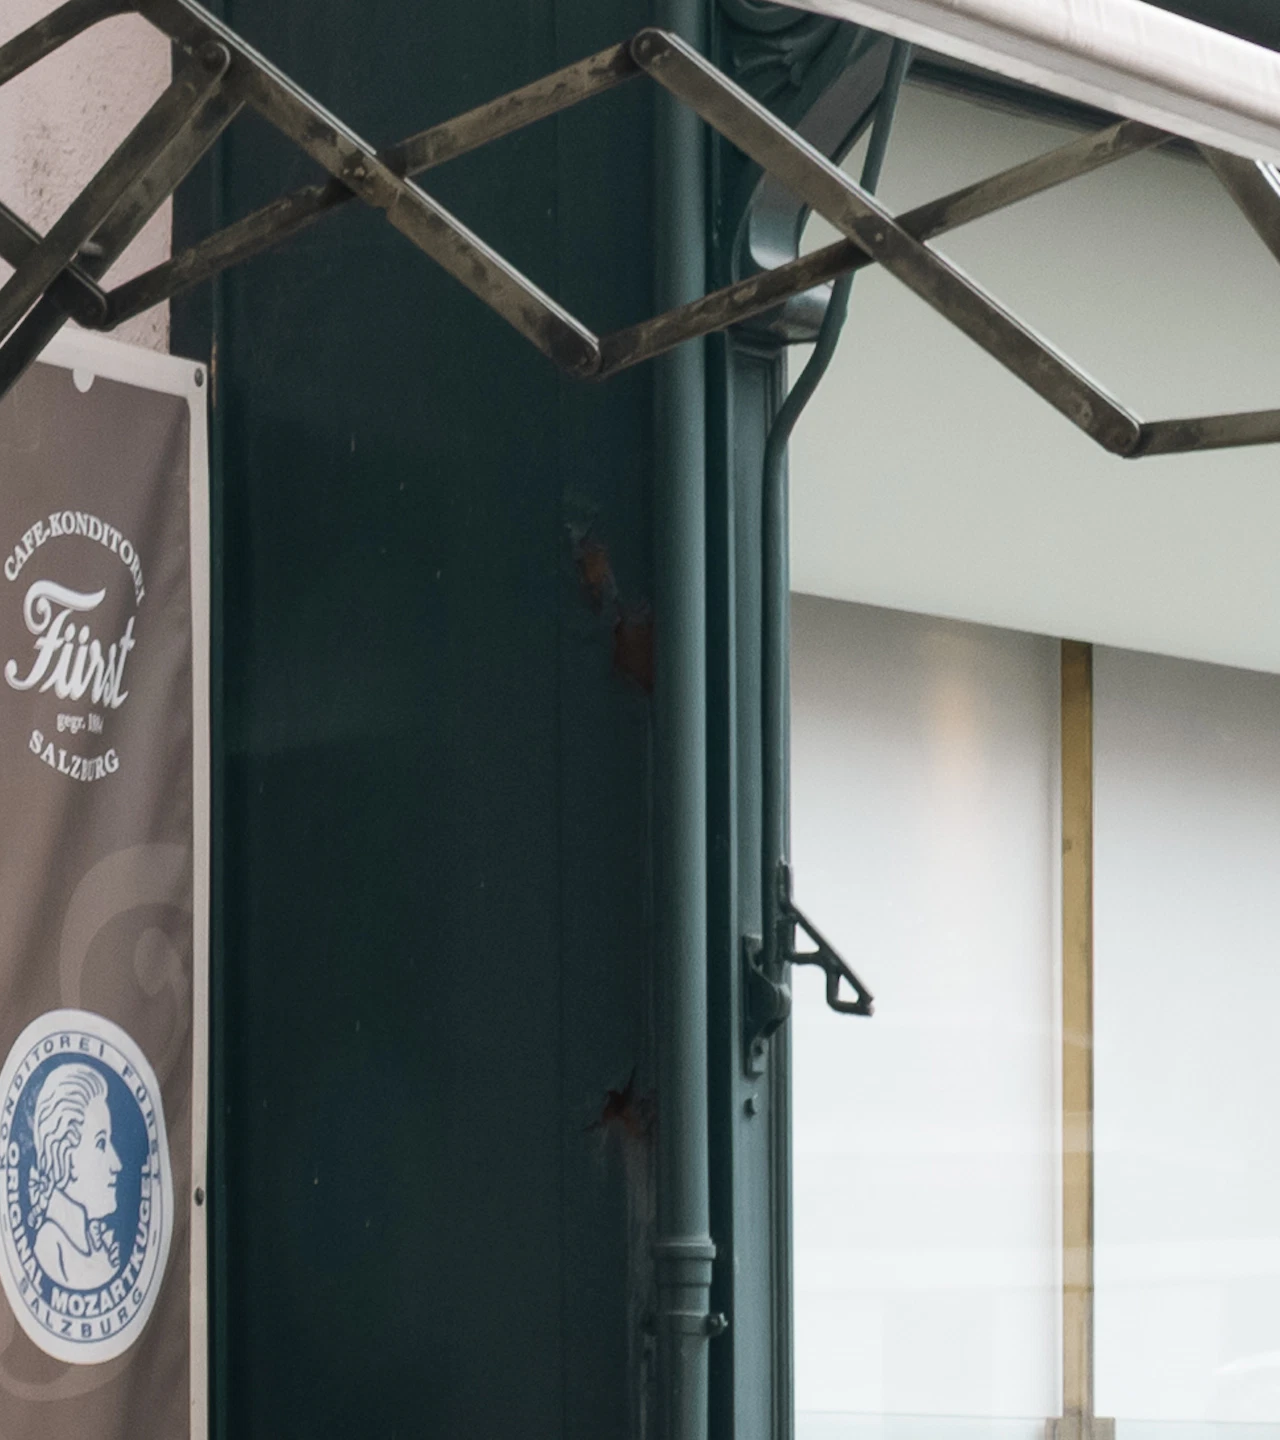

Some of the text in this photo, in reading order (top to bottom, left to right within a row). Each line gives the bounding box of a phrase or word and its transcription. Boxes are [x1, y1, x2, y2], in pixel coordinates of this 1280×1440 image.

[5, 580, 136, 709] Fürst
[56, 713, 86, 734] gegr.
[29, 729, 120, 781] SALZBURG
[7, 1141, 152, 1317] ORIGINAL MOZARTKUGEL
[20, 1277, 143, 1338] SALZBURG
